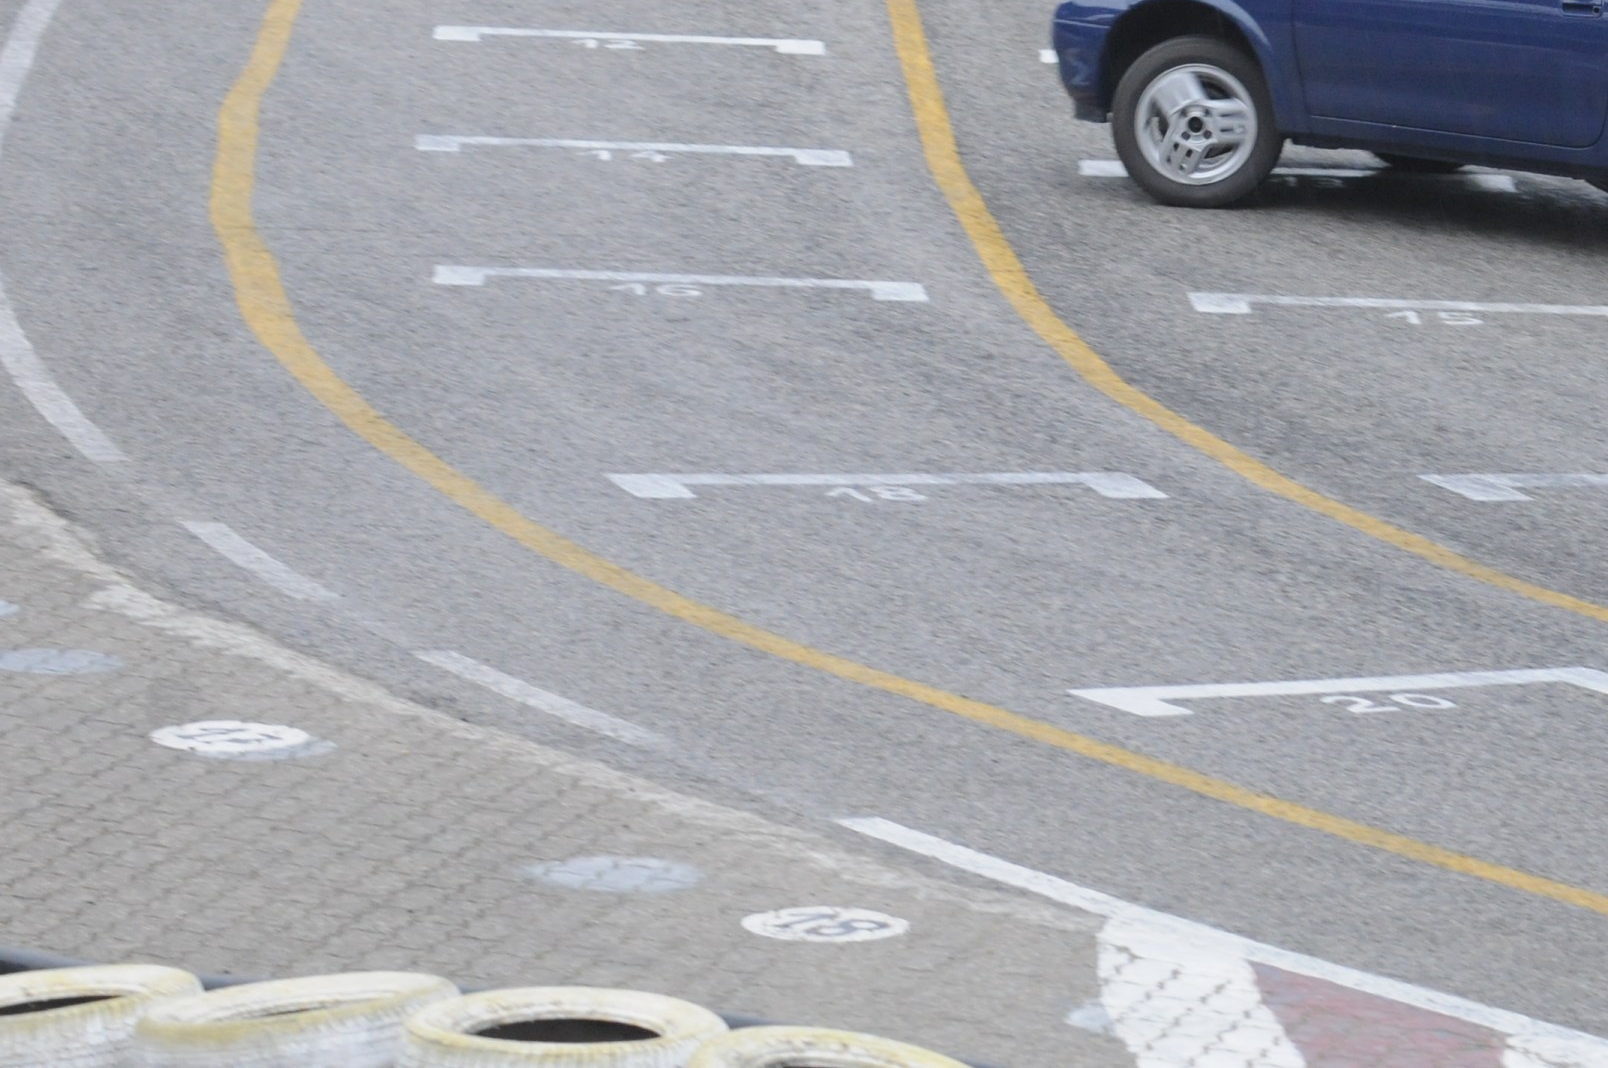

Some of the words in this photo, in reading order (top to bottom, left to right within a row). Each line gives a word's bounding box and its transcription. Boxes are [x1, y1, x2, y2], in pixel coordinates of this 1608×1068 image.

[608, 283, 703, 296] 16
[1383, 311, 1484, 325] 15
[824, 486, 928, 502] 18
[1319, 692, 1458, 713] 20
